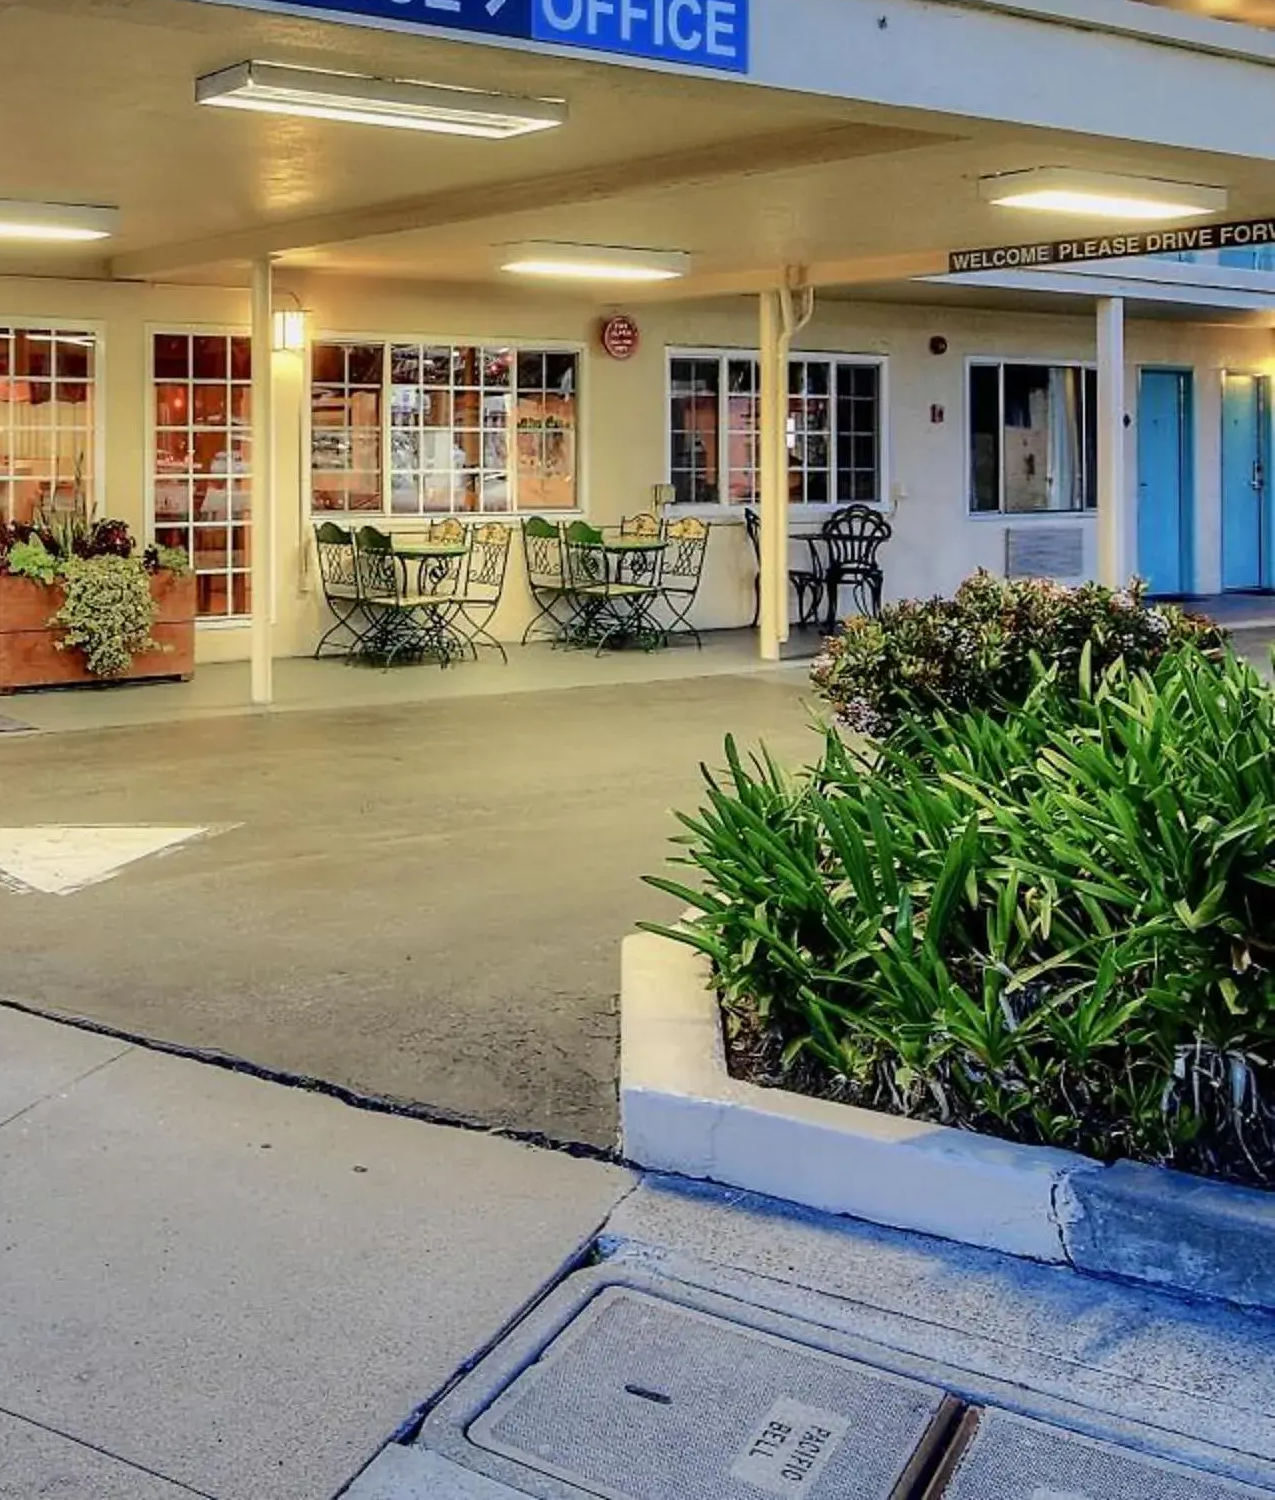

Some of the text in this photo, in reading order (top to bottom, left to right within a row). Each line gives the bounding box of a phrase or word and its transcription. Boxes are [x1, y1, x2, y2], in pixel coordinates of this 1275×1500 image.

[952, 245, 1050, 270] WELCOME
[1058, 235, 1142, 261] PLEASE
[1146, 228, 1214, 252] DRIVE
[748, 1420, 792, 1457] BELL
[781, 1425, 832, 1481] PACIFIC
